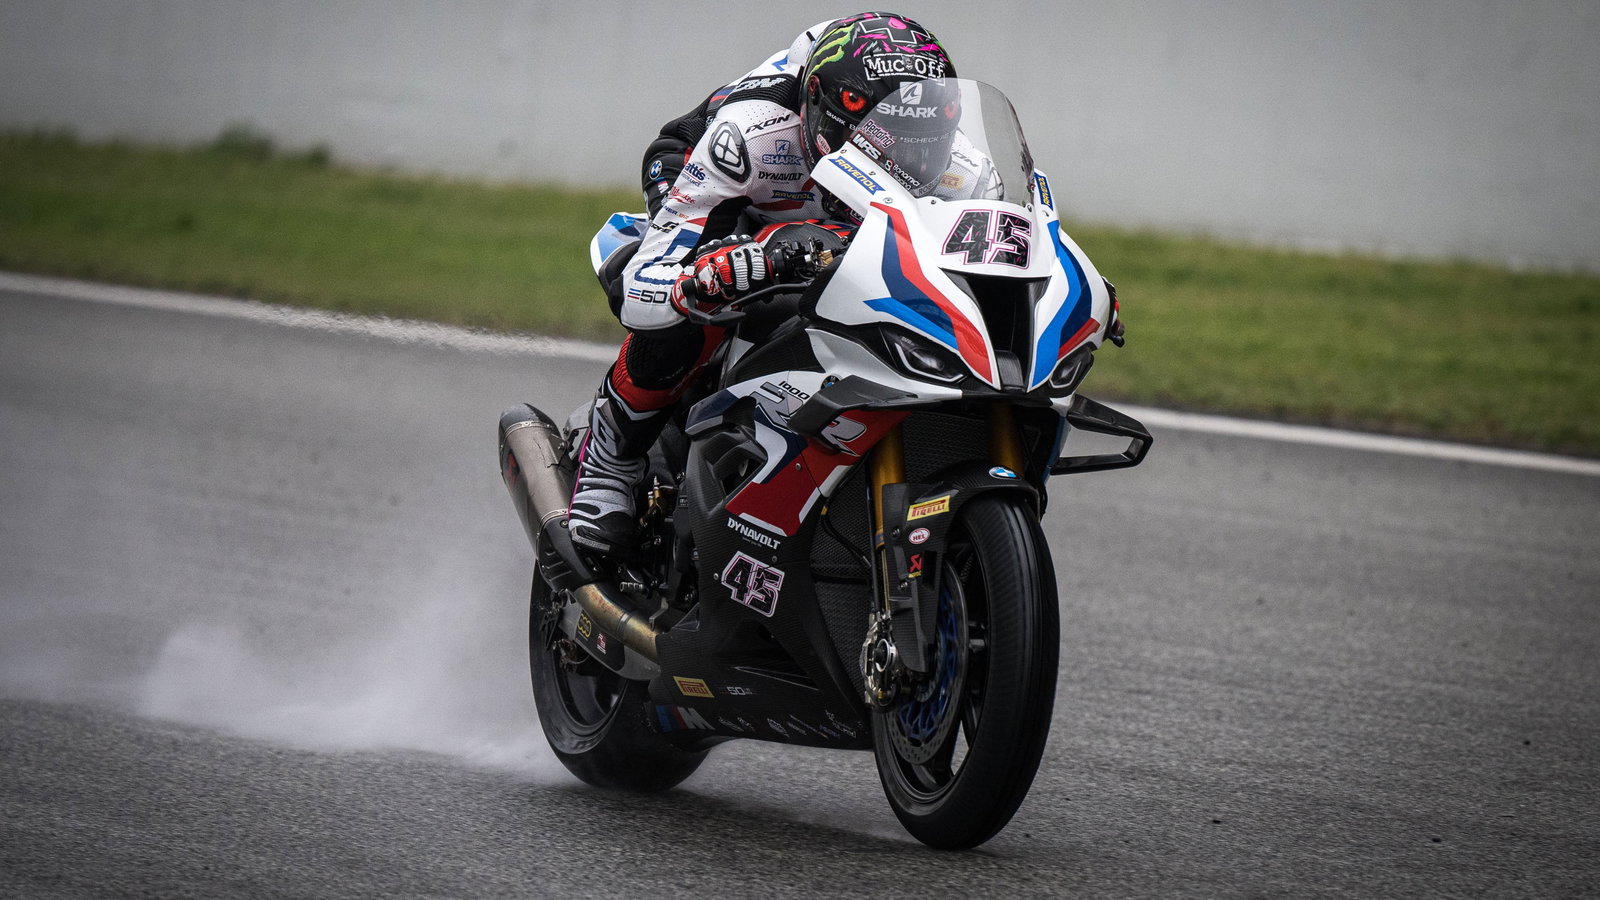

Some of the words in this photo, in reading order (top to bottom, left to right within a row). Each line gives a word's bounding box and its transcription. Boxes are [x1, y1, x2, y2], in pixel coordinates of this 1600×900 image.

[825, 109, 847, 126] SHARK
[876, 103, 938, 119] SHARK
[745, 113, 791, 135] IXON
[852, 133, 882, 160] WRS
[762, 154, 802, 166] SHARK
[758, 171, 804, 181] DYNAVOLT
[834, 157, 877, 191] RAVENOL
[941, 209, 1032, 269] 45
[778, 380, 811, 401] 1000
[911, 499, 946, 518] PIRELLI
[727, 517, 781, 550] DYNAVOLT
[912, 533, 926, 542] HEL
[721, 551, 785, 617] 45
[678, 681, 709, 694] PIRELLI
